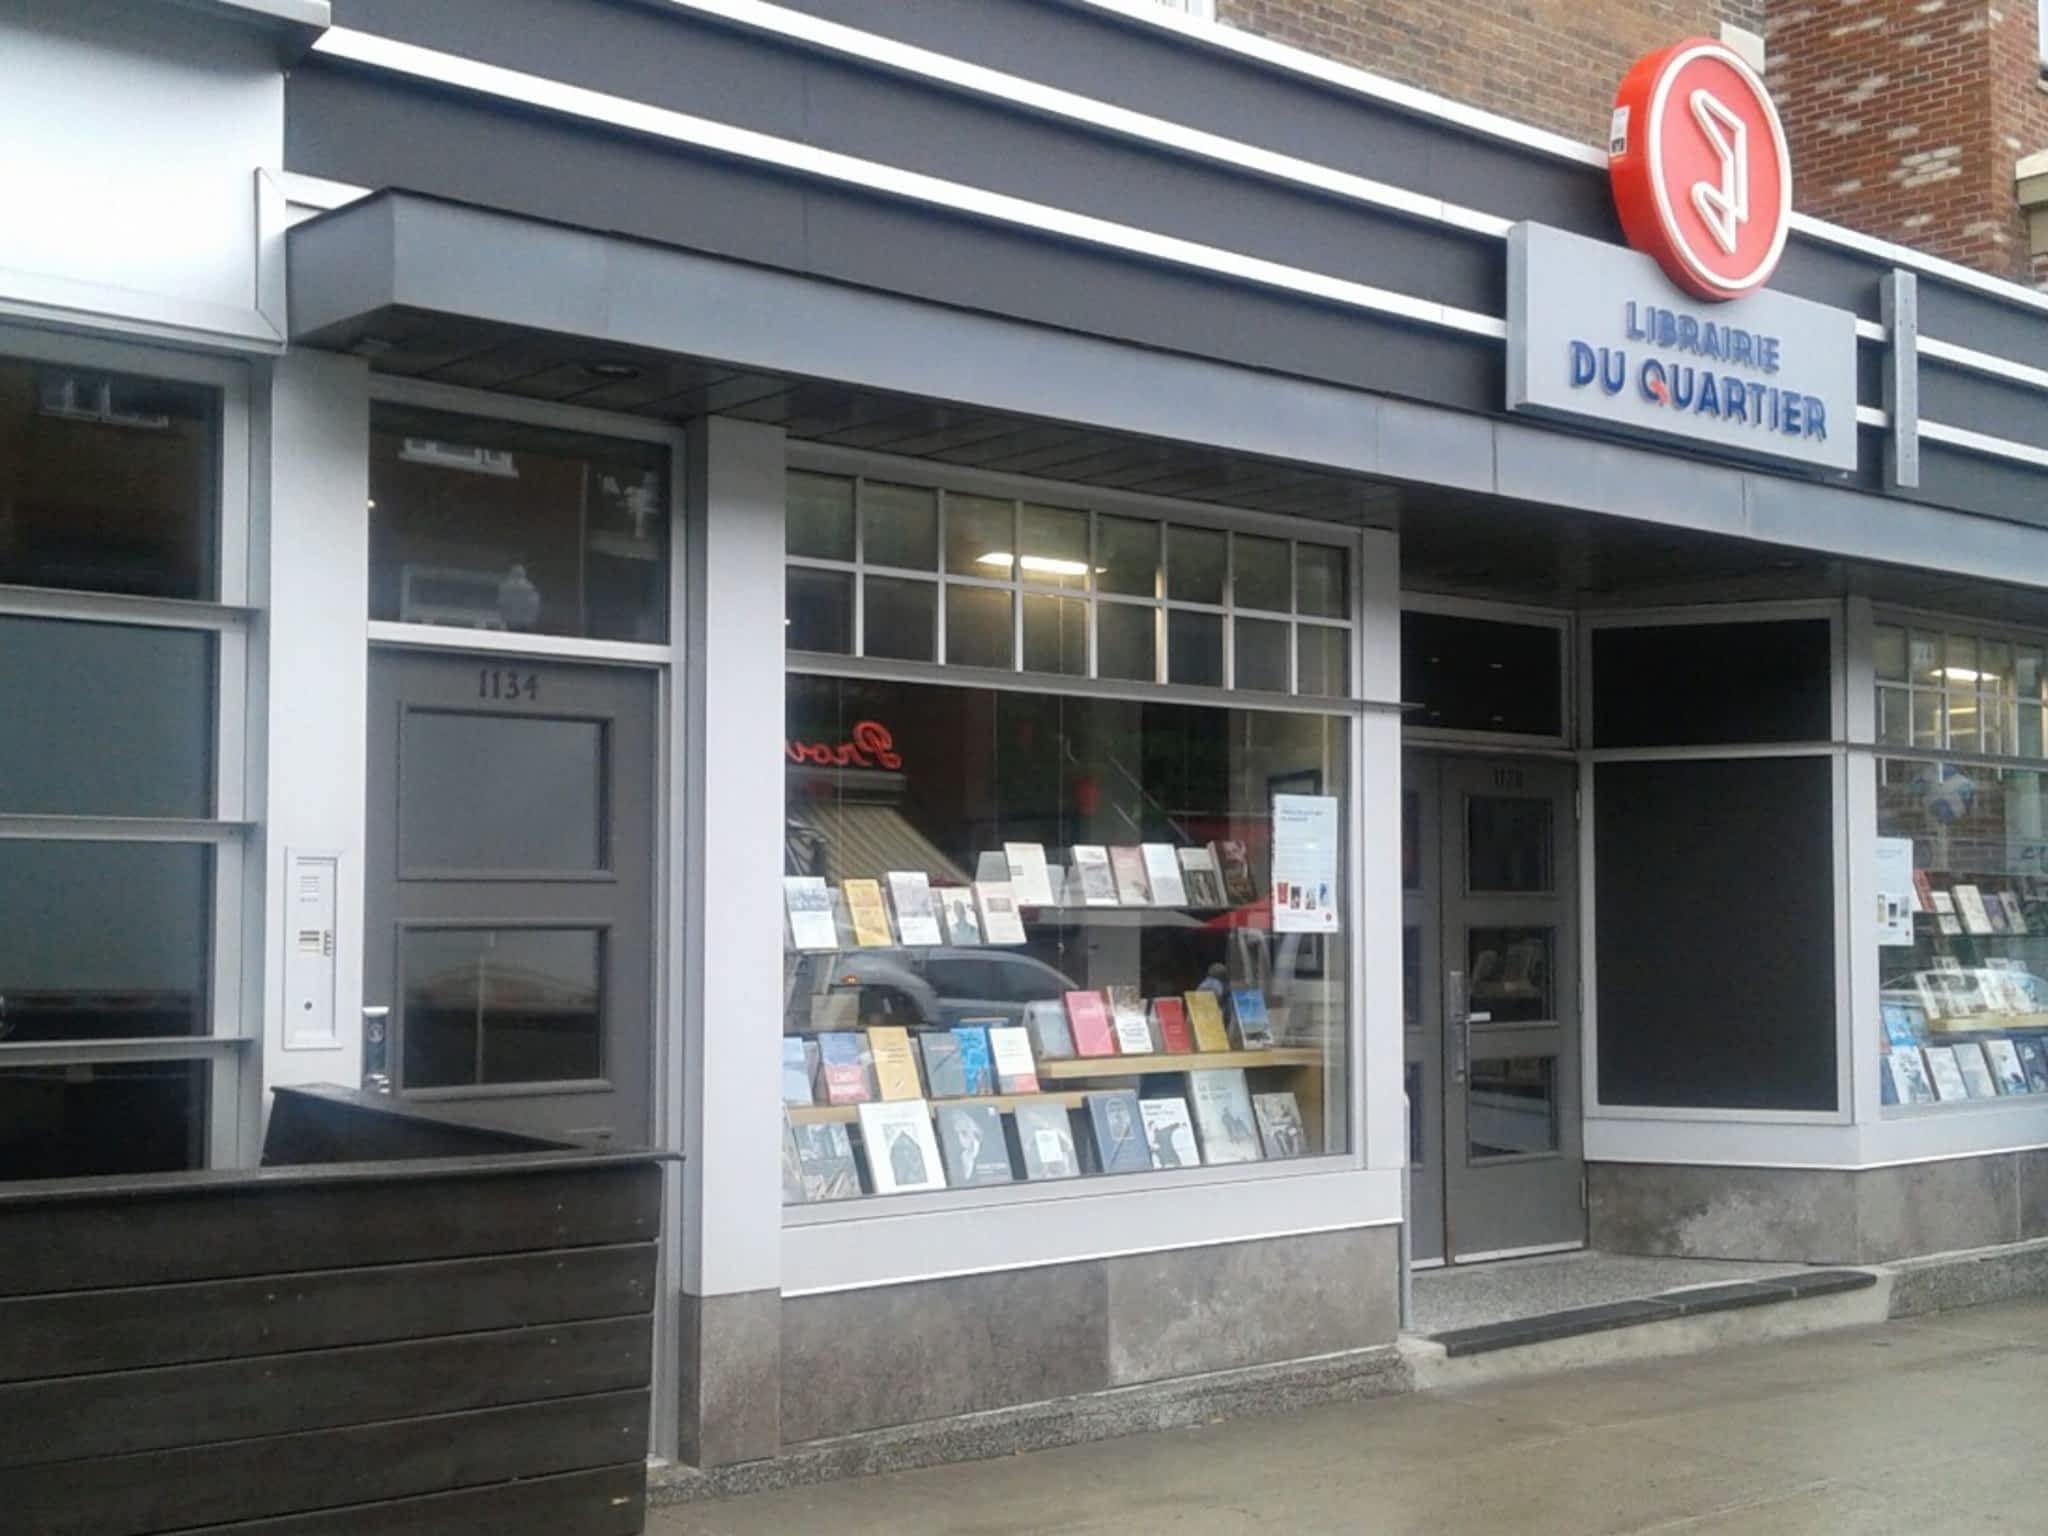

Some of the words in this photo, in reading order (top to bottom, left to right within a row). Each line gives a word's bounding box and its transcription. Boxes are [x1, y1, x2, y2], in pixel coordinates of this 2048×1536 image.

[1626, 300, 1781, 374] LIBRAIRIE
[1570, 340, 1625, 395] DU
[1640, 358, 1827, 442] QUARTIER
[479, 669, 540, 701] 1134
